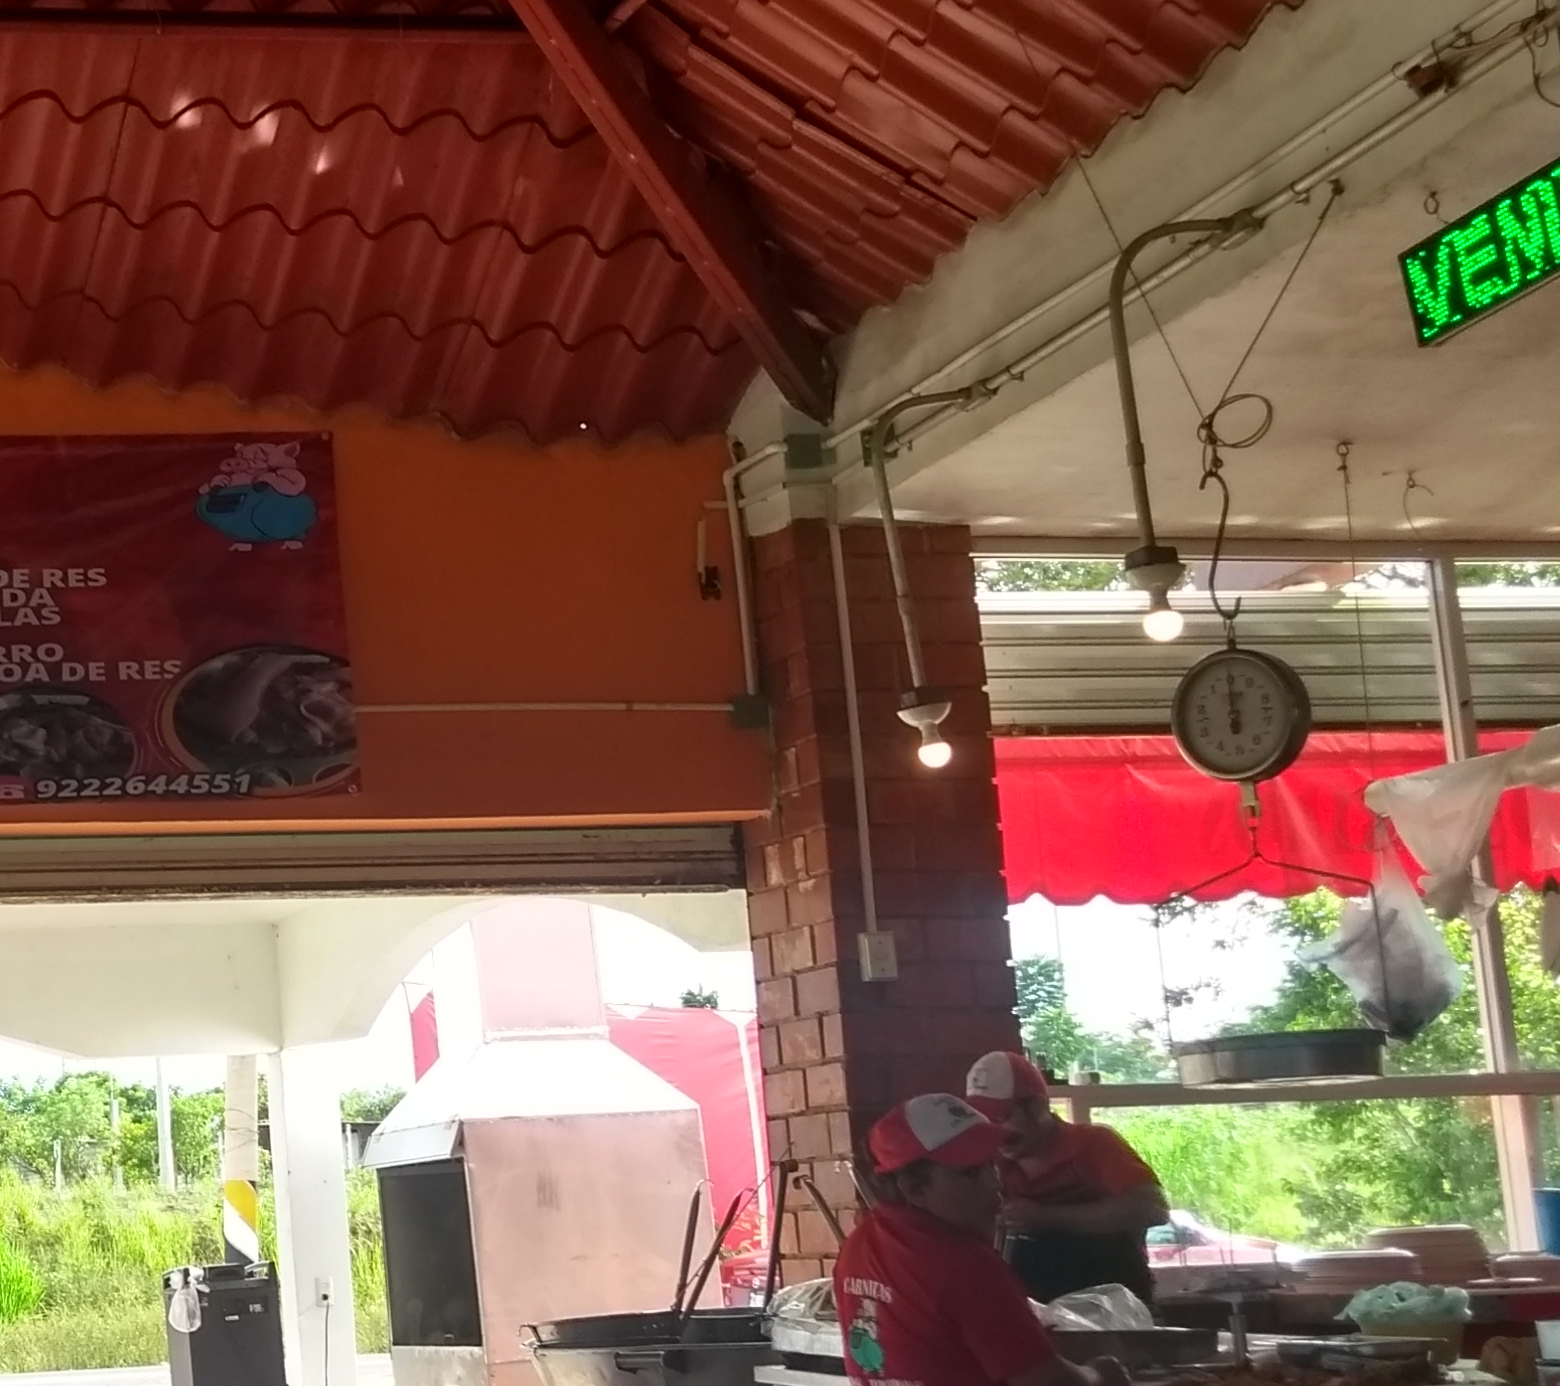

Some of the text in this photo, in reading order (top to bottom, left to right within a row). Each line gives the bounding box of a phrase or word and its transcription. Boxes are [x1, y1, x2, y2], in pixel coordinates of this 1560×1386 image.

[43, 568, 107, 587] RES
[62, 662, 106, 682] DE
[119, 660, 182, 680] RES
[37, 774, 251, 799] 9222644551
